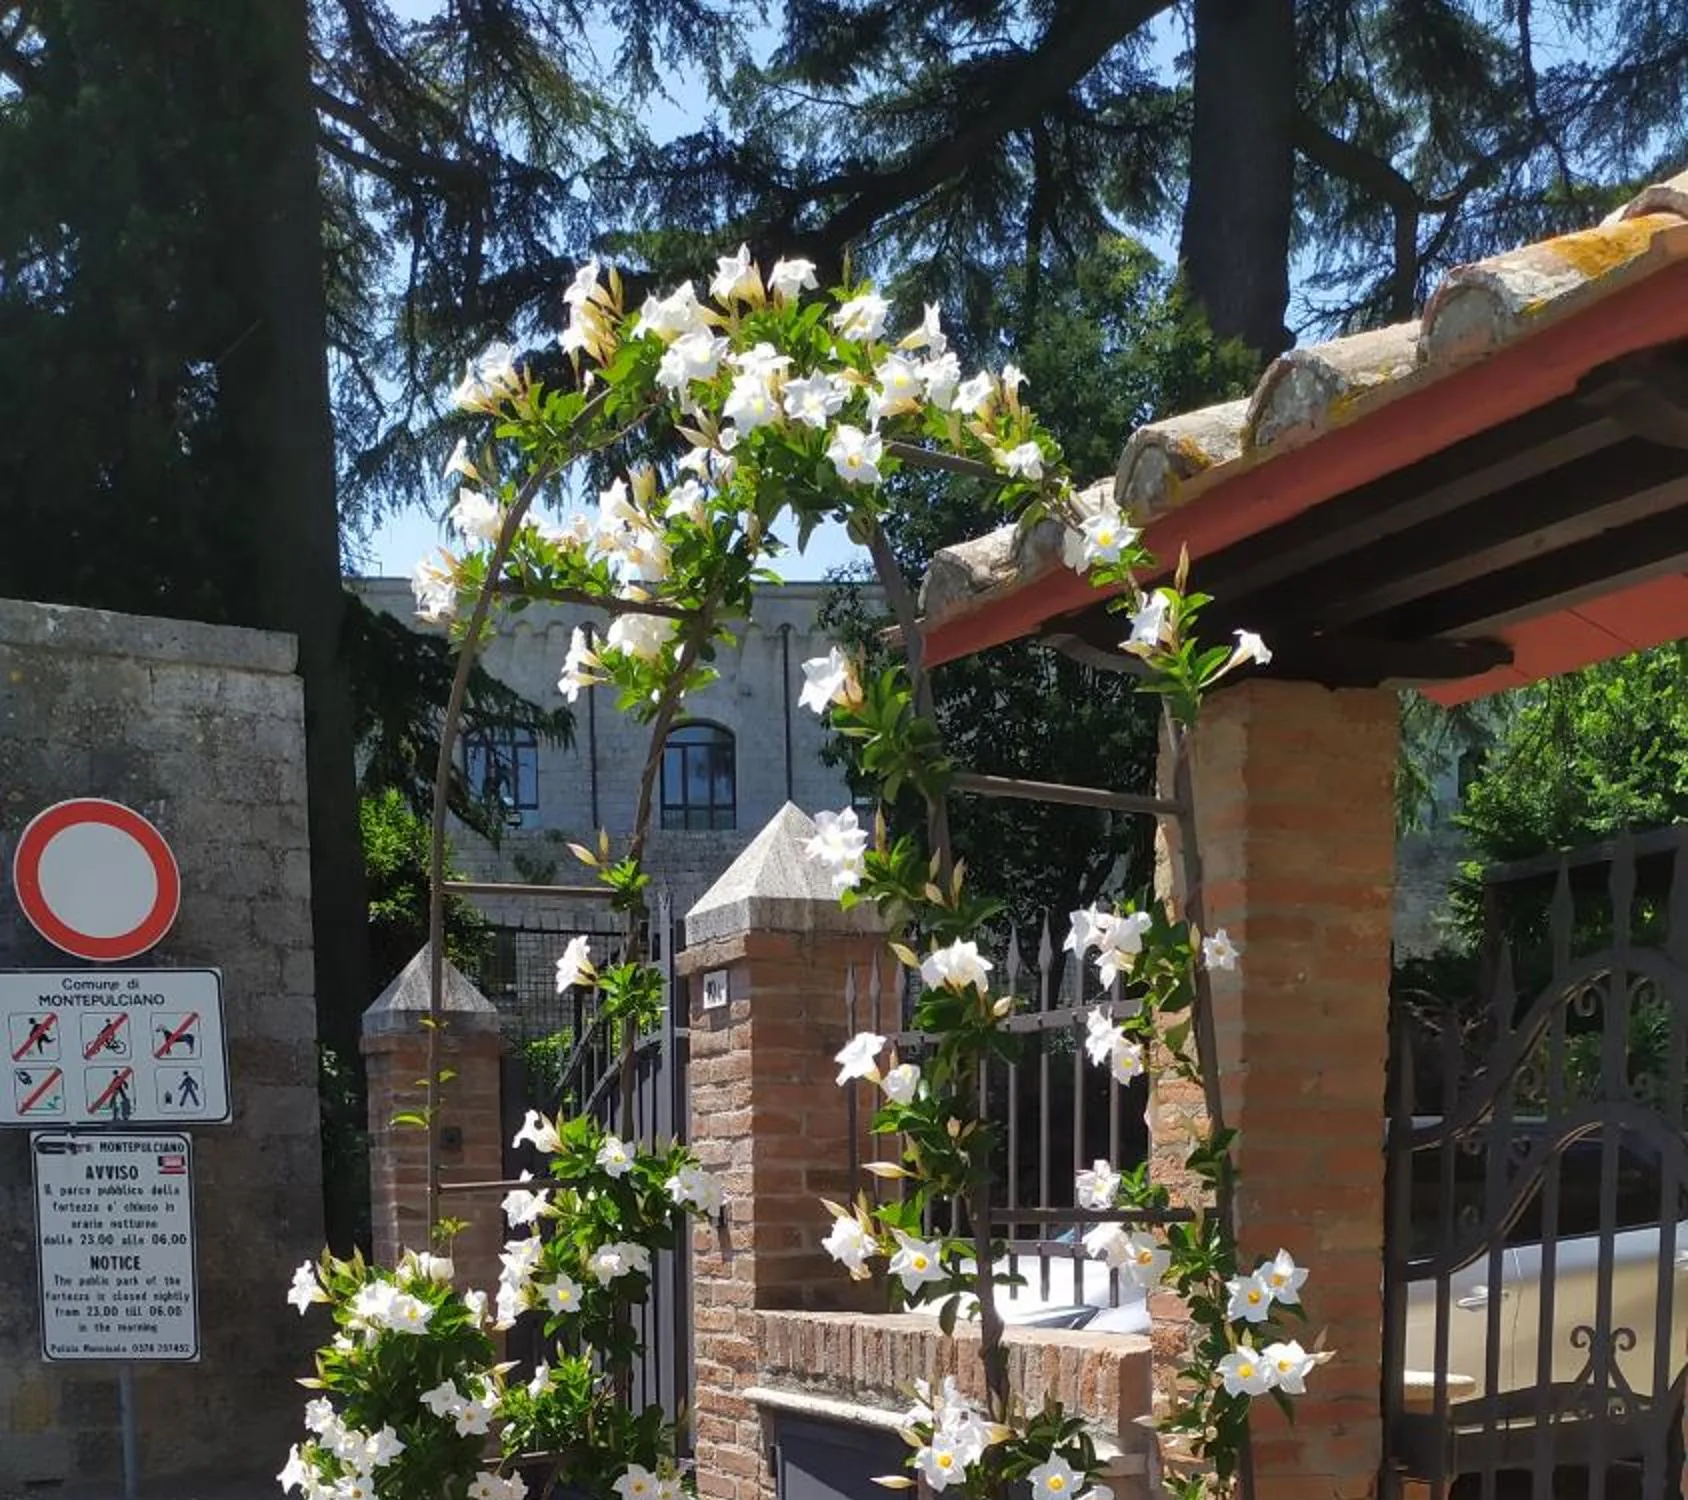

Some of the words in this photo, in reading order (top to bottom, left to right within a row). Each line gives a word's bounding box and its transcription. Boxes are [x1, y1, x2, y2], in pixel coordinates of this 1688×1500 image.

[62, 978, 119, 991] Comune
[128, 978, 139, 990] di
[39, 994, 165, 1007] MONTEPULCIANO
[100, 1141, 185, 1152] MONTEPULCIANO
[85, 1165, 139, 1180] AVVISO
[60, 1186, 91, 1197] parco
[98, 1184, 143, 1197] pubblico
[152, 1185, 180, 1195] della
[53, 1202, 99, 1212] fortezza
[124, 1202, 158, 1212] chiuso
[71, 1219, 102, 1229] orario
[110, 1219, 158, 1229] notturno
[43, 1234, 73, 1245] dalle
[80, 1234, 114, 1245] 23.00
[121, 1235, 144, 1245] alle
[90, 1256, 141, 1270] NOTICE
[54, 1274, 72, 1286] The
[79, 1274, 109, 1286] public
[116, 1276, 138, 1286] park
[146, 1276, 157, 1285] of
[164, 1276, 180, 1285] the
[112, 1291, 146, 1301] closed
[153, 1292, 190, 1304] nightly
[55, 1307, 80, 1317] from
[87, 1306, 119, 1317] 23.00
[125, 1306, 142, 1316] till
[149, 1306, 183, 1317] 06.00
[94, 1323, 110, 1332] the
